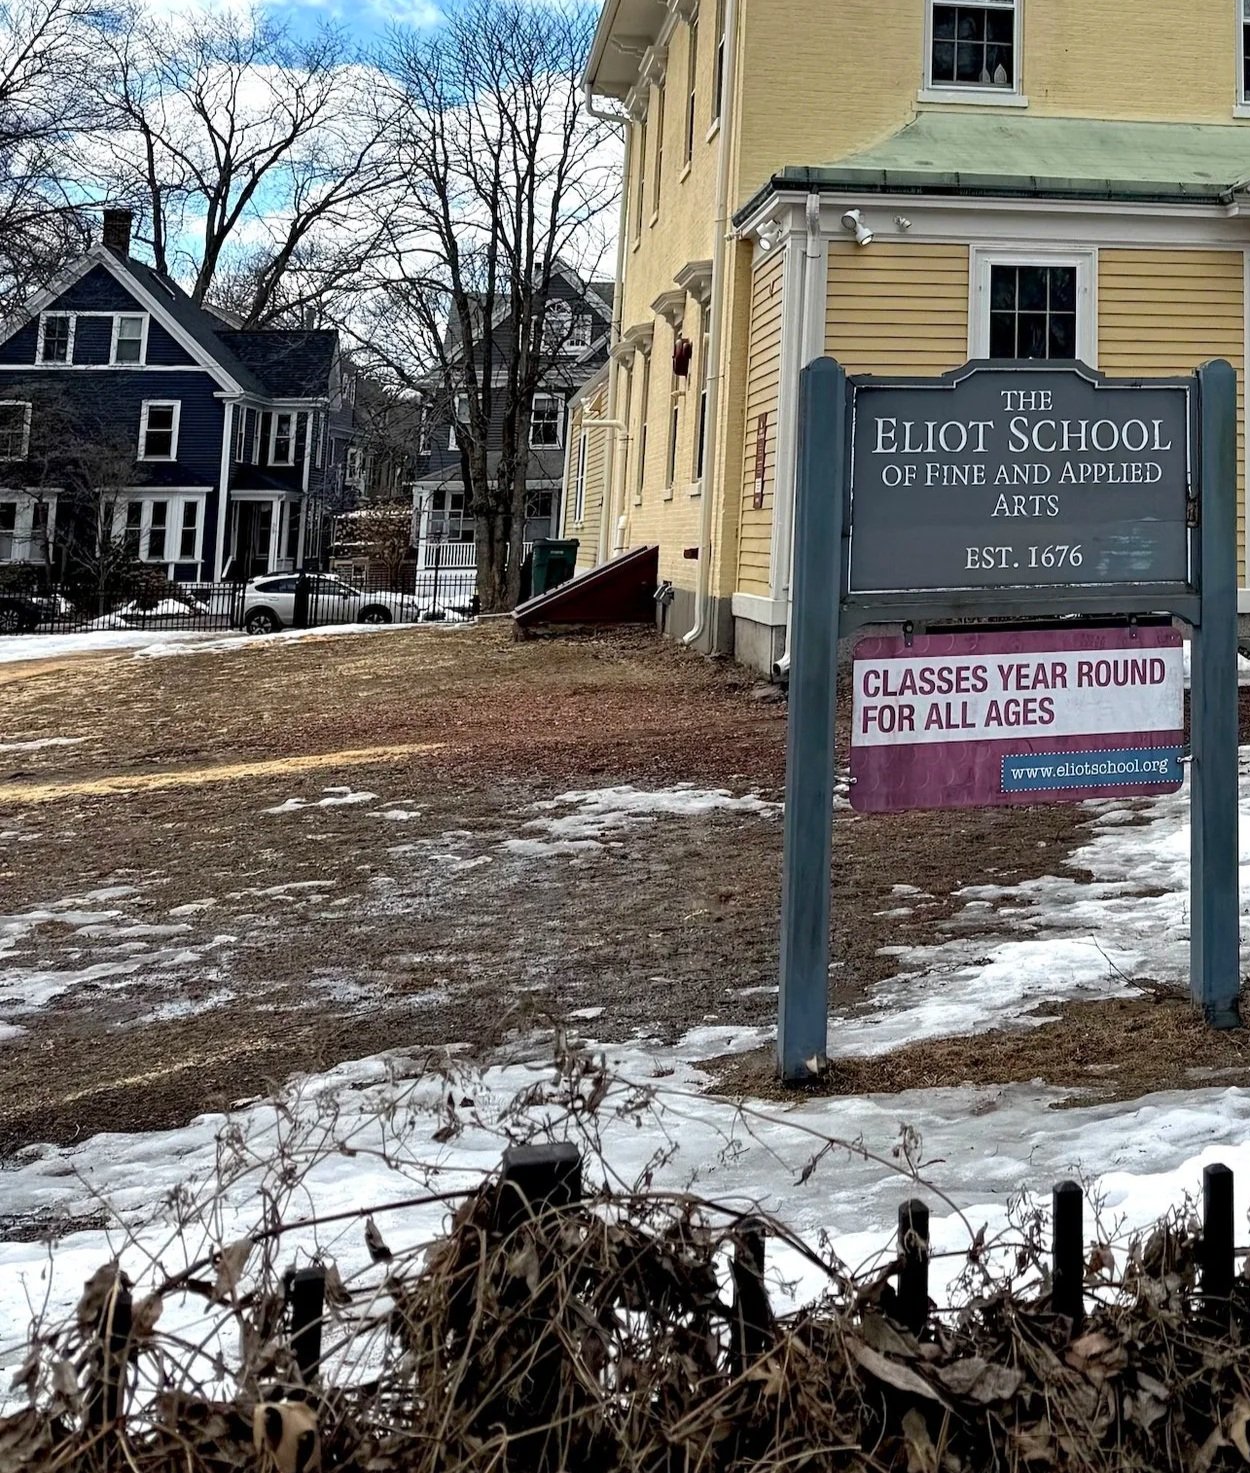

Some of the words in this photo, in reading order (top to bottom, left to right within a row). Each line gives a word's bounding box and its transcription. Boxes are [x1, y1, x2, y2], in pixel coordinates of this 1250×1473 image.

[1001, 390, 1053, 411] THE
[872, 417, 994, 454] ELIOT
[1008, 416, 1172, 452] SCHOOL
[882, 464, 917, 487] OF
[925, 463, 986, 486] FINE
[994, 464, 1051, 485] AND
[1058, 461, 1162, 484] APPLIED
[990, 493, 1059, 517] ARTS
[965, 547, 1019, 569] EST.
[1028, 545, 1083, 568] 1676
[863, 665, 988, 698] CLASSES
[998, 662, 1067, 691] YEAR
[1077, 658, 1165, 688] ROUND
[862, 703, 915, 734] FOR
[924, 701, 975, 730] ALL
[984, 697, 1055, 728] AGES
[1010, 758, 1169, 781] www.eliotschool.org
